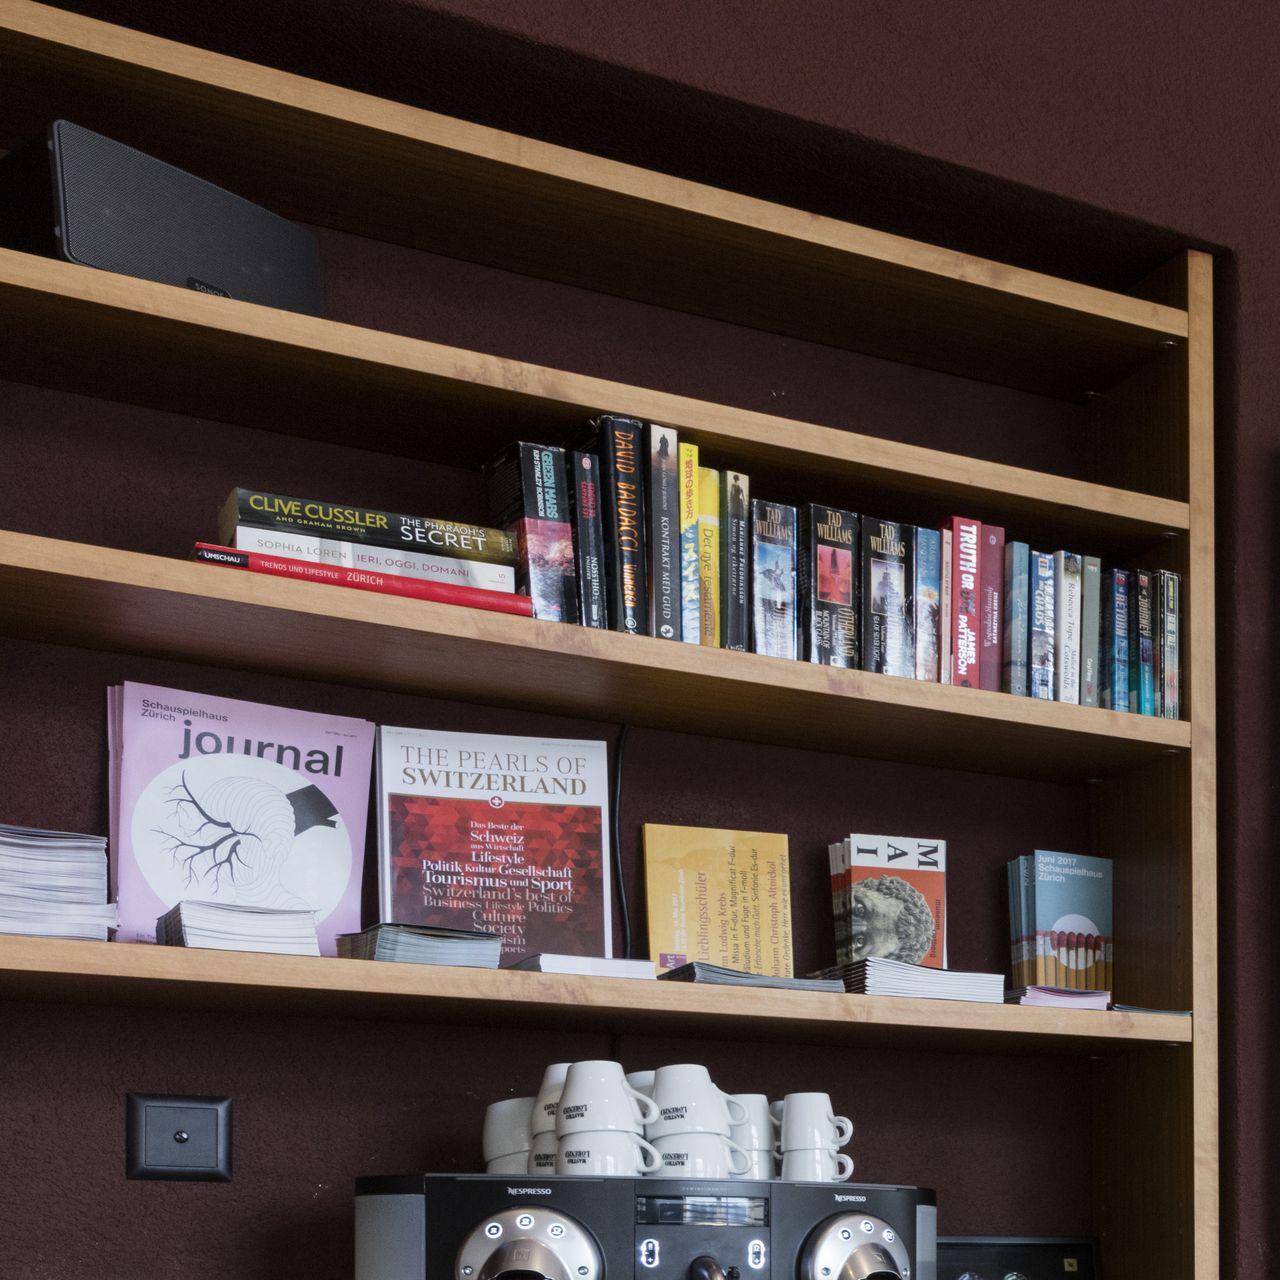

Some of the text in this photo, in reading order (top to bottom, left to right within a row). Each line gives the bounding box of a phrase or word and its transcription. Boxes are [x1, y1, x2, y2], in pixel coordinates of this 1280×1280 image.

[541, 451, 559, 520] GREEN MARS
[614, 430, 639, 552] DAVID BALDACCI
[250, 494, 388, 529] CLIVE CUSSLER
[765, 507, 782, 524] TAD
[827, 510, 842, 526] TAD
[276, 515, 366, 533] AND GRAHAM BROWN
[400, 516, 485, 537] THE PHARAOH'S
[756, 519, 792, 540] WILLIAMS
[817, 523, 853, 544] WILLIAMS
[879, 524, 895, 540] TAD
[400, 525, 486, 551] SECRET
[870, 536, 905, 557] WILLIAMS
[204, 551, 241, 563] UMSCHAU
[256, 538, 347, 560] SOPHIA LOREN
[959, 524, 977, 591] TRUTH OR
[261, 560, 383, 586] TRENDS UND LIFESTYLE ZÜRICH
[356, 553, 469, 578] IERI, OGGI, DOMANI
[661, 516, 671, 620] KONTRAKT MED GUD
[591, 557, 600, 596] OHLSSON
[702, 528, 714, 638] Det nye testamente
[838, 608, 855, 657] OTHERLAND
[957, 614, 967, 675] PATTERSON
[967, 628, 976, 665] JAMES
[141, 708, 176, 722] Zürich
[142, 699, 229, 722] Schauspielhaus
[178, 720, 344, 777] journal
[401, 745, 587, 775] THE PEARLS OF
[402, 767, 587, 796] SWITZERLAND
[470, 821, 525, 831] Das Beste der
[470, 831, 525, 844] Schweiz
[485, 843, 525, 852] Wirtschaft
[422, 859, 572, 878] Politik Kultur Gesellschaft
[471, 851, 525, 866] Lifestyle
[1038, 855, 1077, 866] Juni 2017
[1038, 863, 1103, 879] Schauspielhaus
[1038, 872, 1066, 883] Zürich
[422, 870, 573, 894] Tourismus und Sport
[422, 884, 575, 903] Switzerland's best of
[423, 895, 573, 913] Business Lifestyle Politics
[717, 892, 728, 917] Krebs
[472, 910, 526, 923] Culture
[769, 902, 779, 944] Christoph
[473, 922, 526, 935] Society
[719, 918, 730, 954] Ludwig
[563, 1104, 587, 1115] LORENZO
[565, 1111, 585, 1120] MASTRO
[661, 1106, 687, 1116] LORENZO
[663, 1112, 685, 1121] MASTRO
[565, 1150, 590, 1159] LORENZO
[662, 1152, 688, 1161] LORENZO
[507, 1186, 552, 1196] NESPRESSO
[834, 1193, 866, 1202] NESPRESSO
